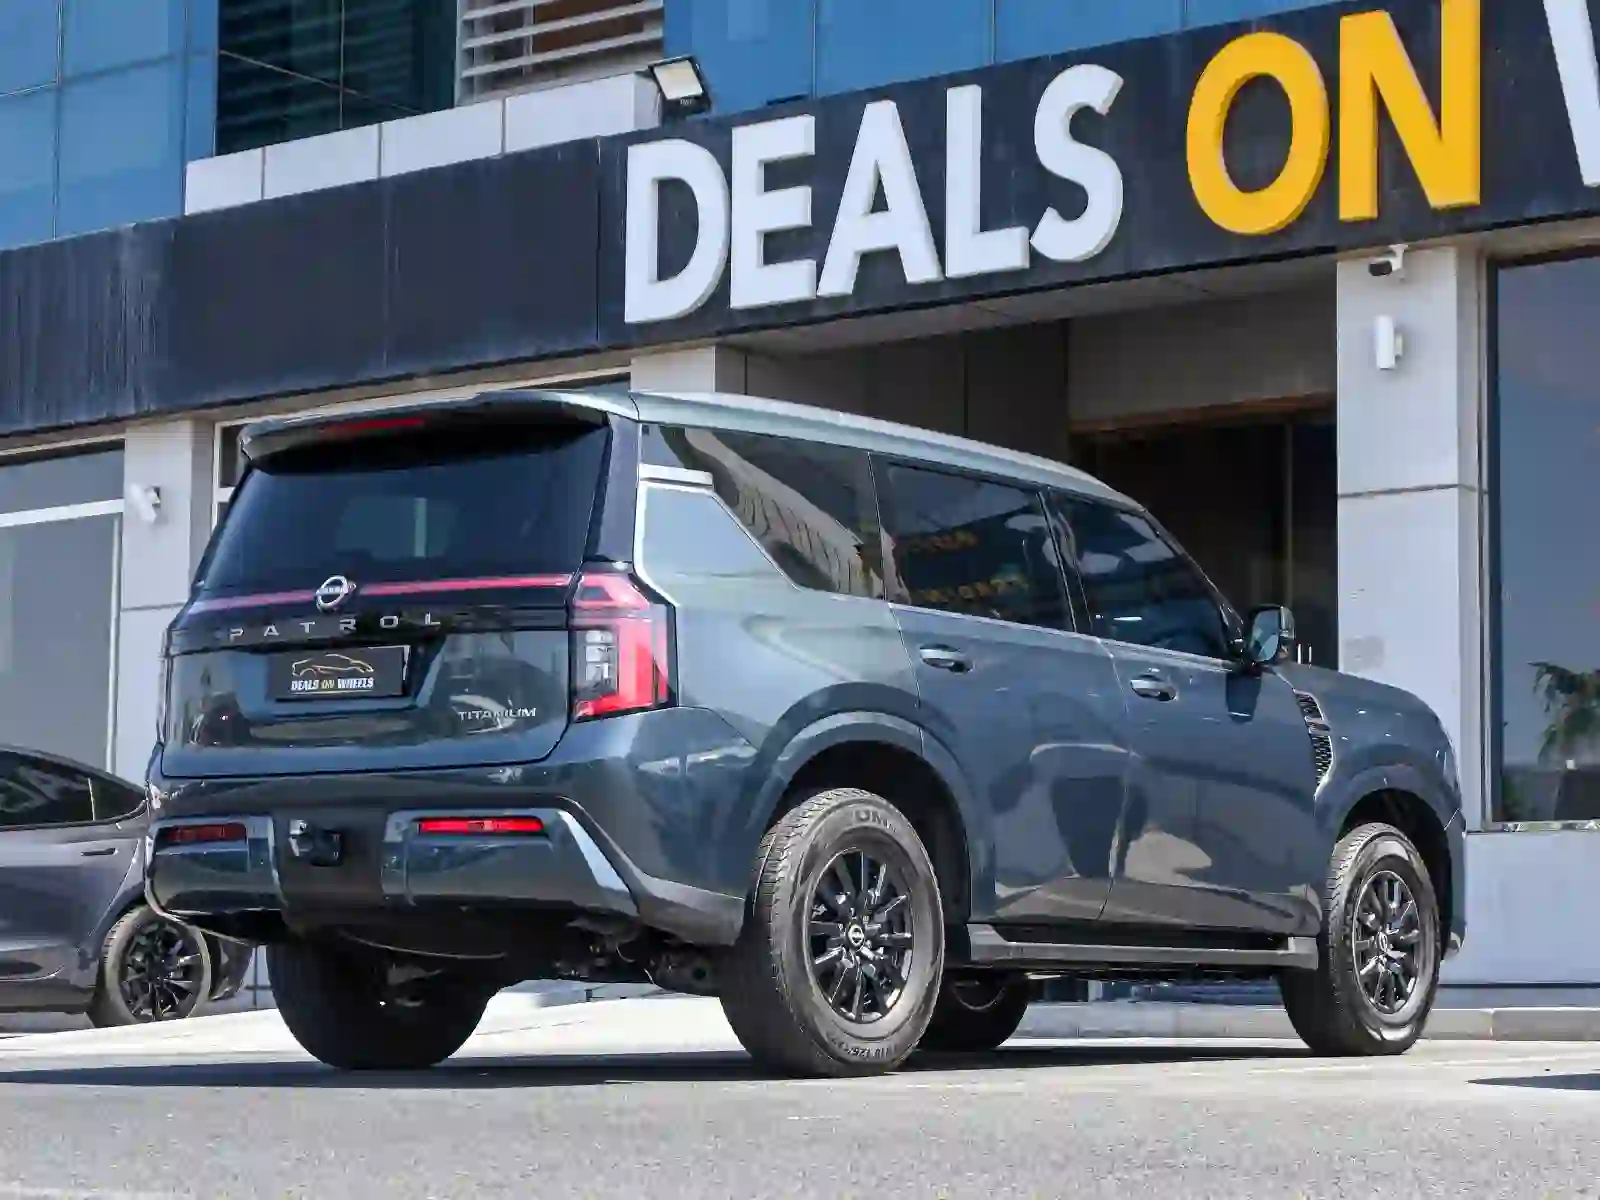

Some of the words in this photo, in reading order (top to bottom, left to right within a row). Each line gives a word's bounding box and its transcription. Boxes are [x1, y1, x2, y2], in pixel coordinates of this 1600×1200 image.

[624, 64, 1124, 324] DEALS
[1186, 0, 1481, 236] ON
[229, 611, 441, 642] PATROL
[291, 680, 319, 691] DEALS
[337, 677, 374, 689] WHEELS
[458, 707, 537, 721] TITANIUM
